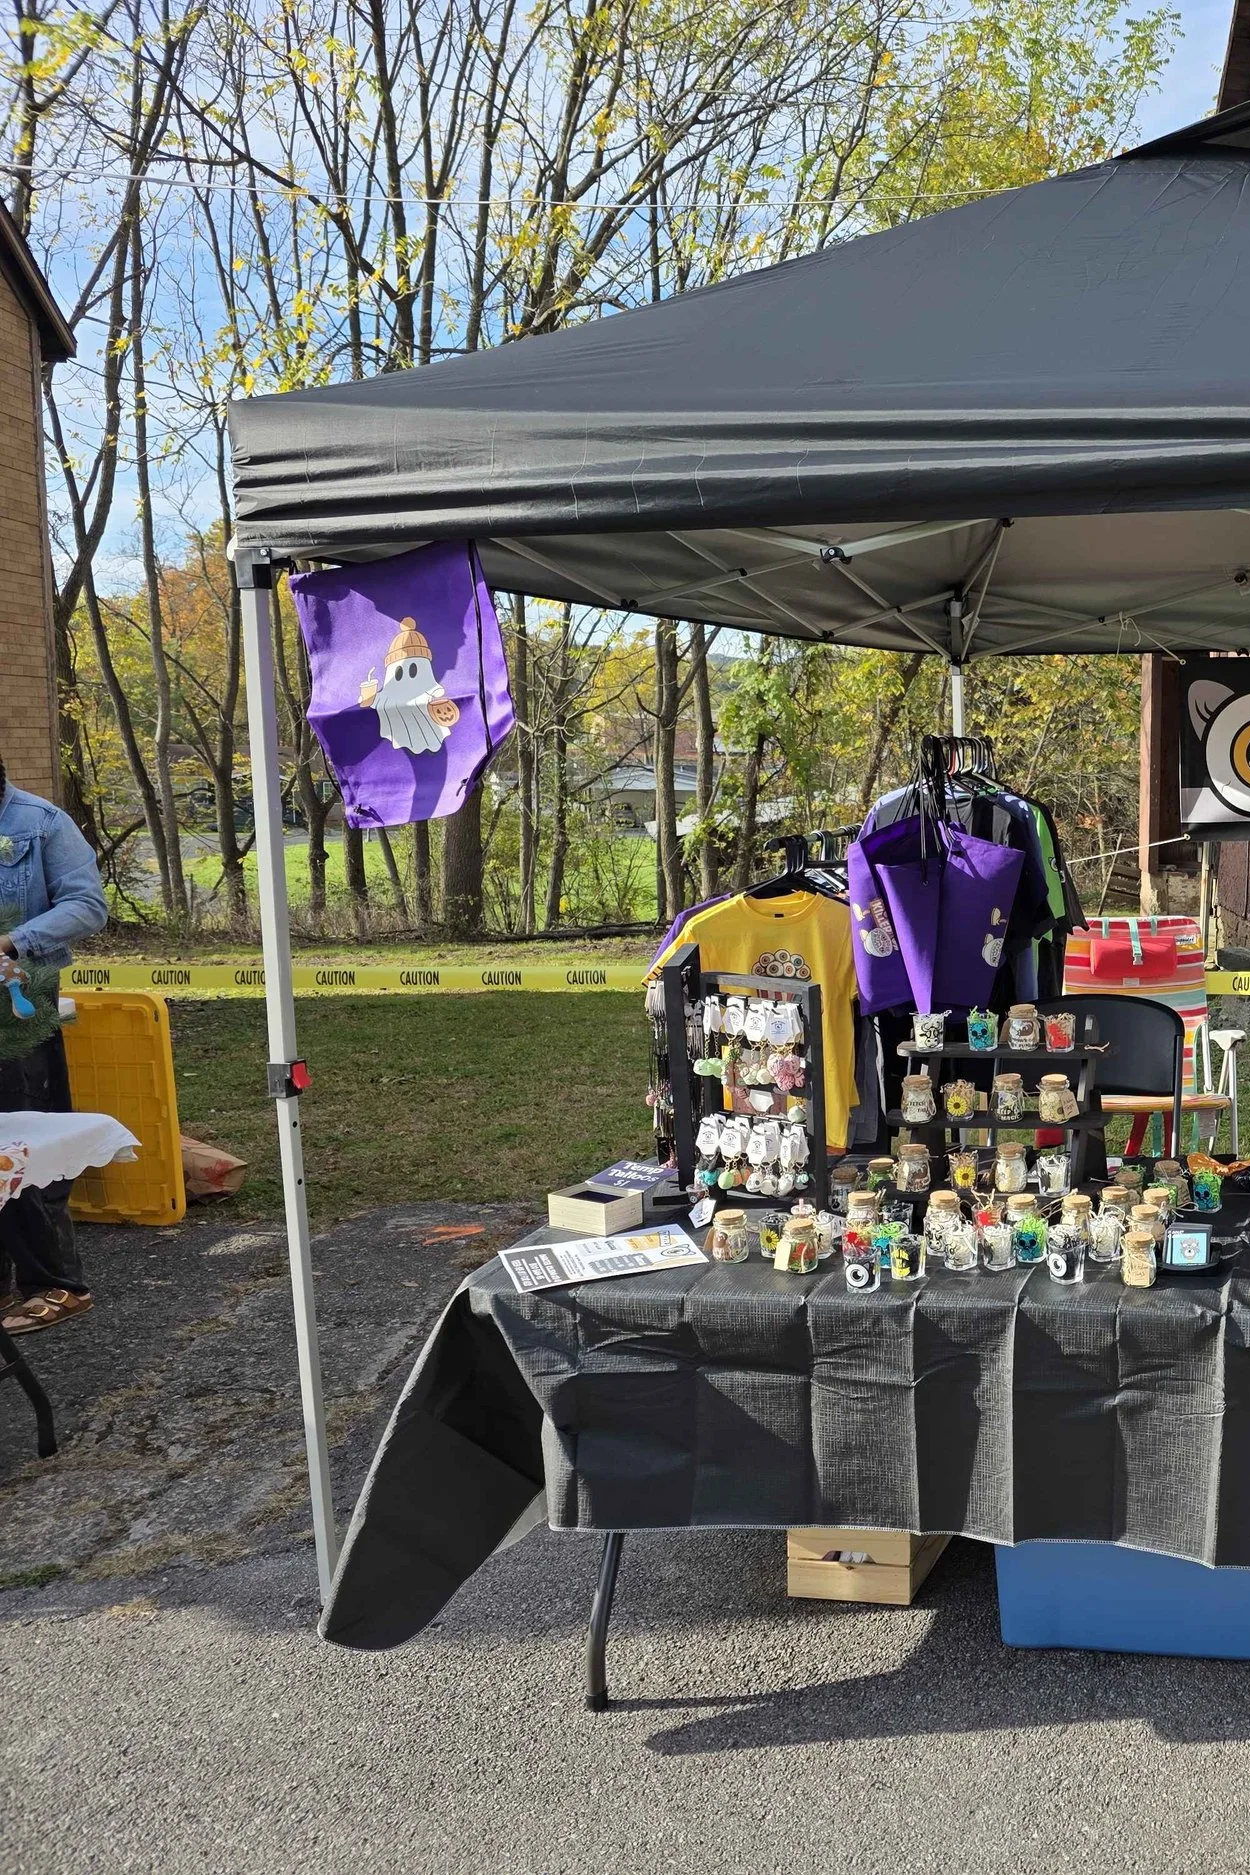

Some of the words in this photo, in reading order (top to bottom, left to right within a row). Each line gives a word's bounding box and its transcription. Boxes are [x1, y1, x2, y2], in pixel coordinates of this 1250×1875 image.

[71, 969, 110, 985] CAUTION
[151, 969, 191, 985] CAUTION
[234, 970, 265, 985] CAUTIO
[315, 970, 356, 986] CAUTION
[399, 970, 440, 986] CAUTION
[481, 970, 522, 986] CAUTION
[566, 970, 607, 985] CAUTION
[608, 1168, 659, 1182] Tattoos
[623, 1162, 664, 1174] Temp
